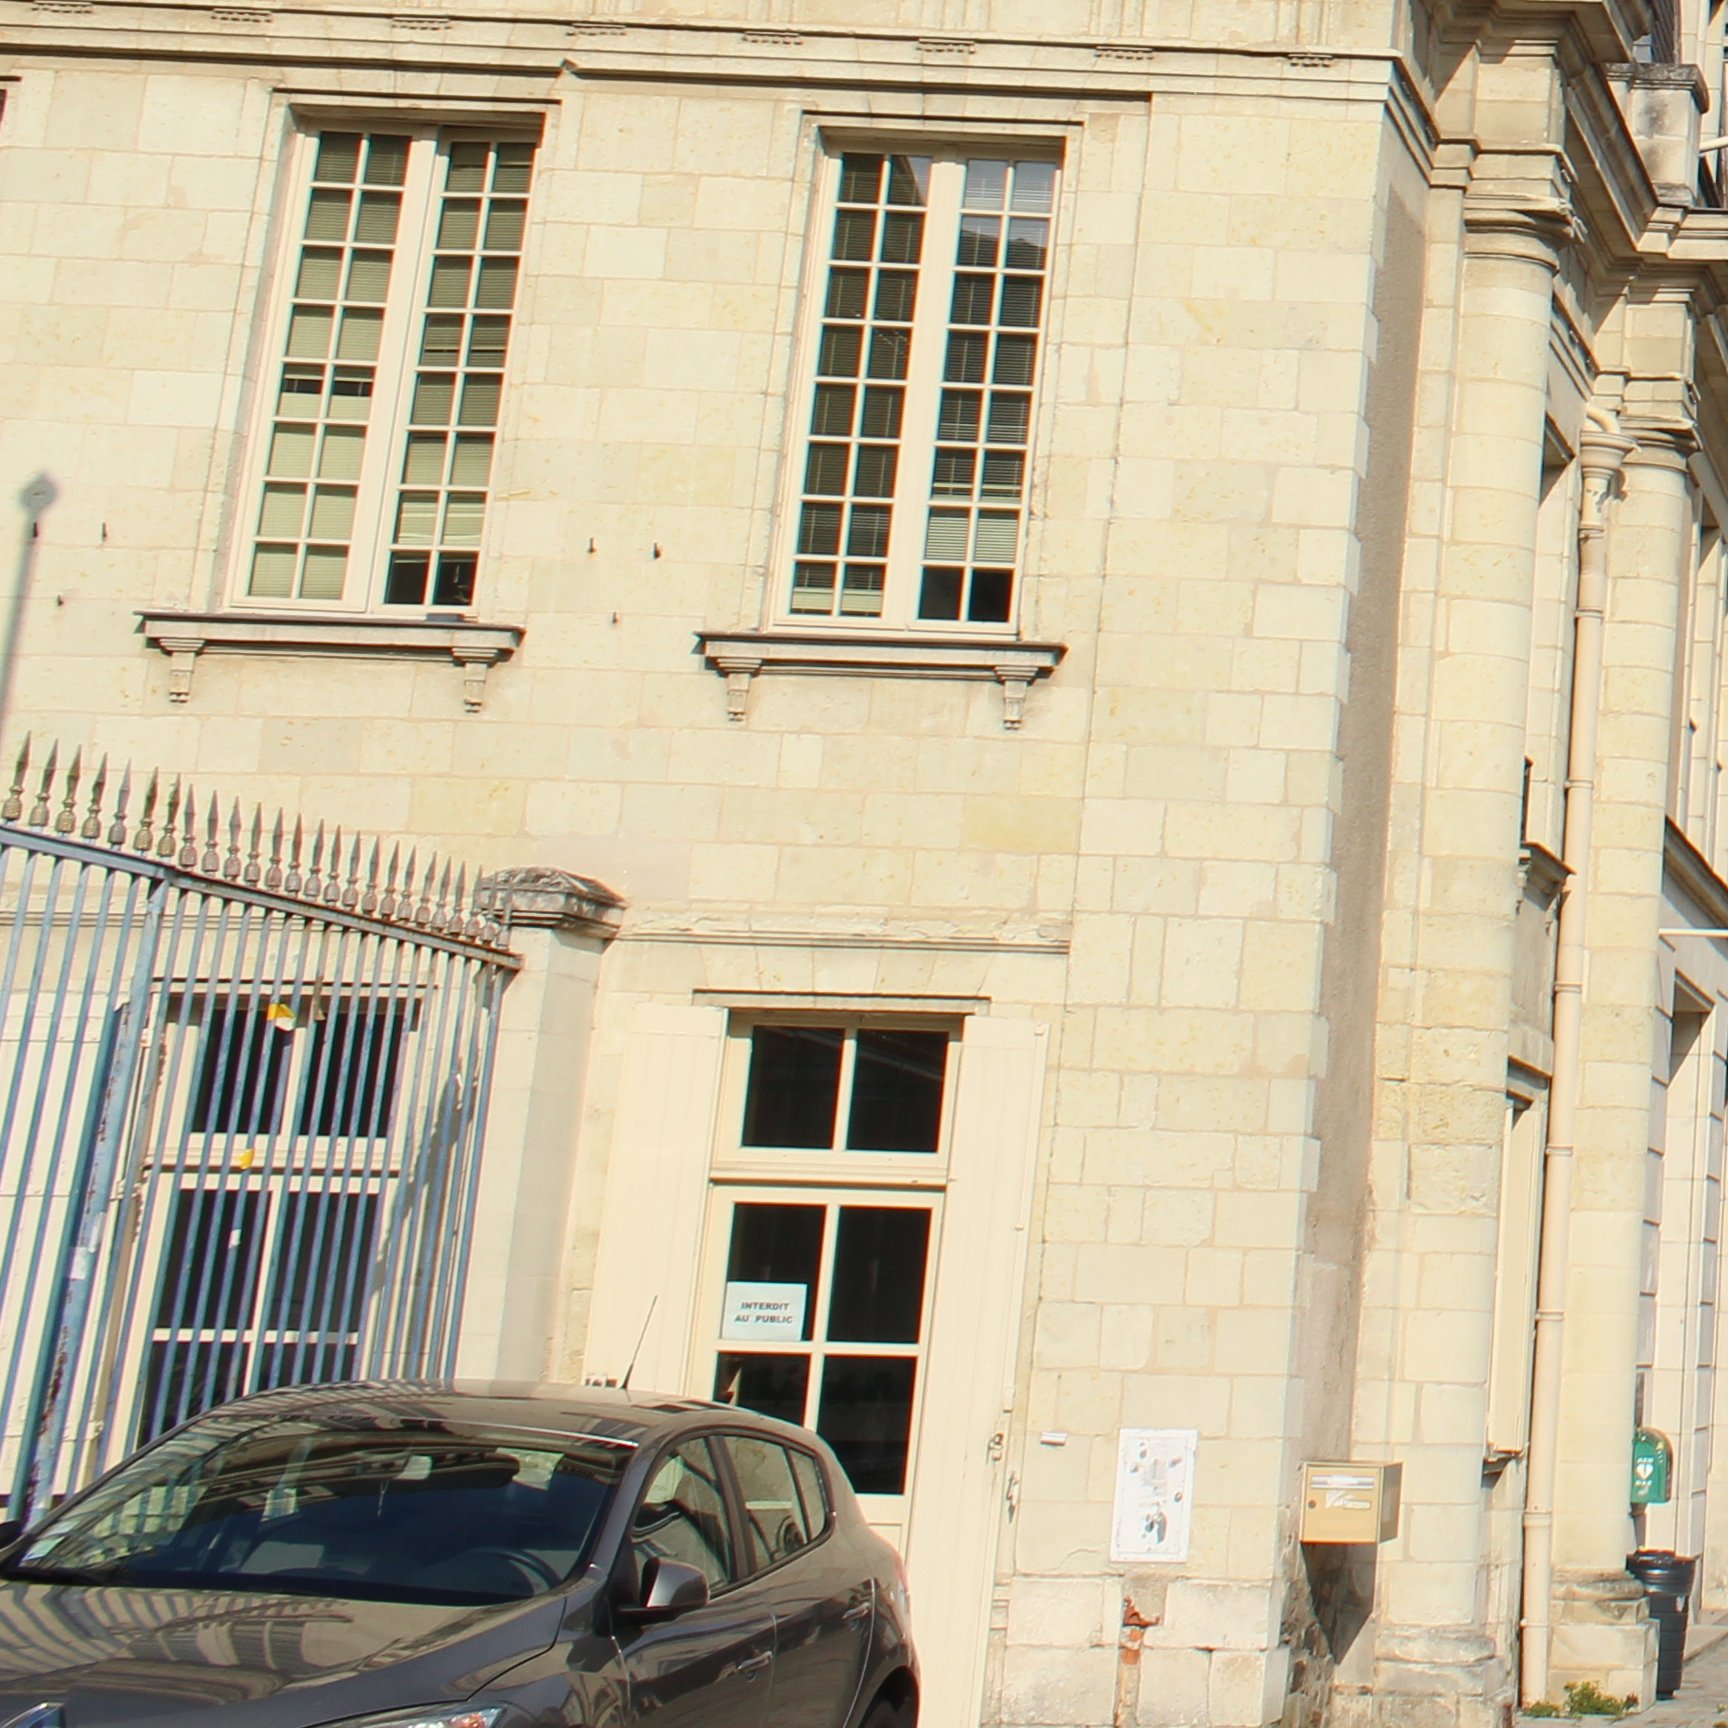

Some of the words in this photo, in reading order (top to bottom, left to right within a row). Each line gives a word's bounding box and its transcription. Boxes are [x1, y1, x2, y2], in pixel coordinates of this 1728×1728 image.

[740, 1302, 790, 1311] INTERDIT
[735, 1315, 750, 1323] AU
[755, 1315, 793, 1324] PUBLIC
